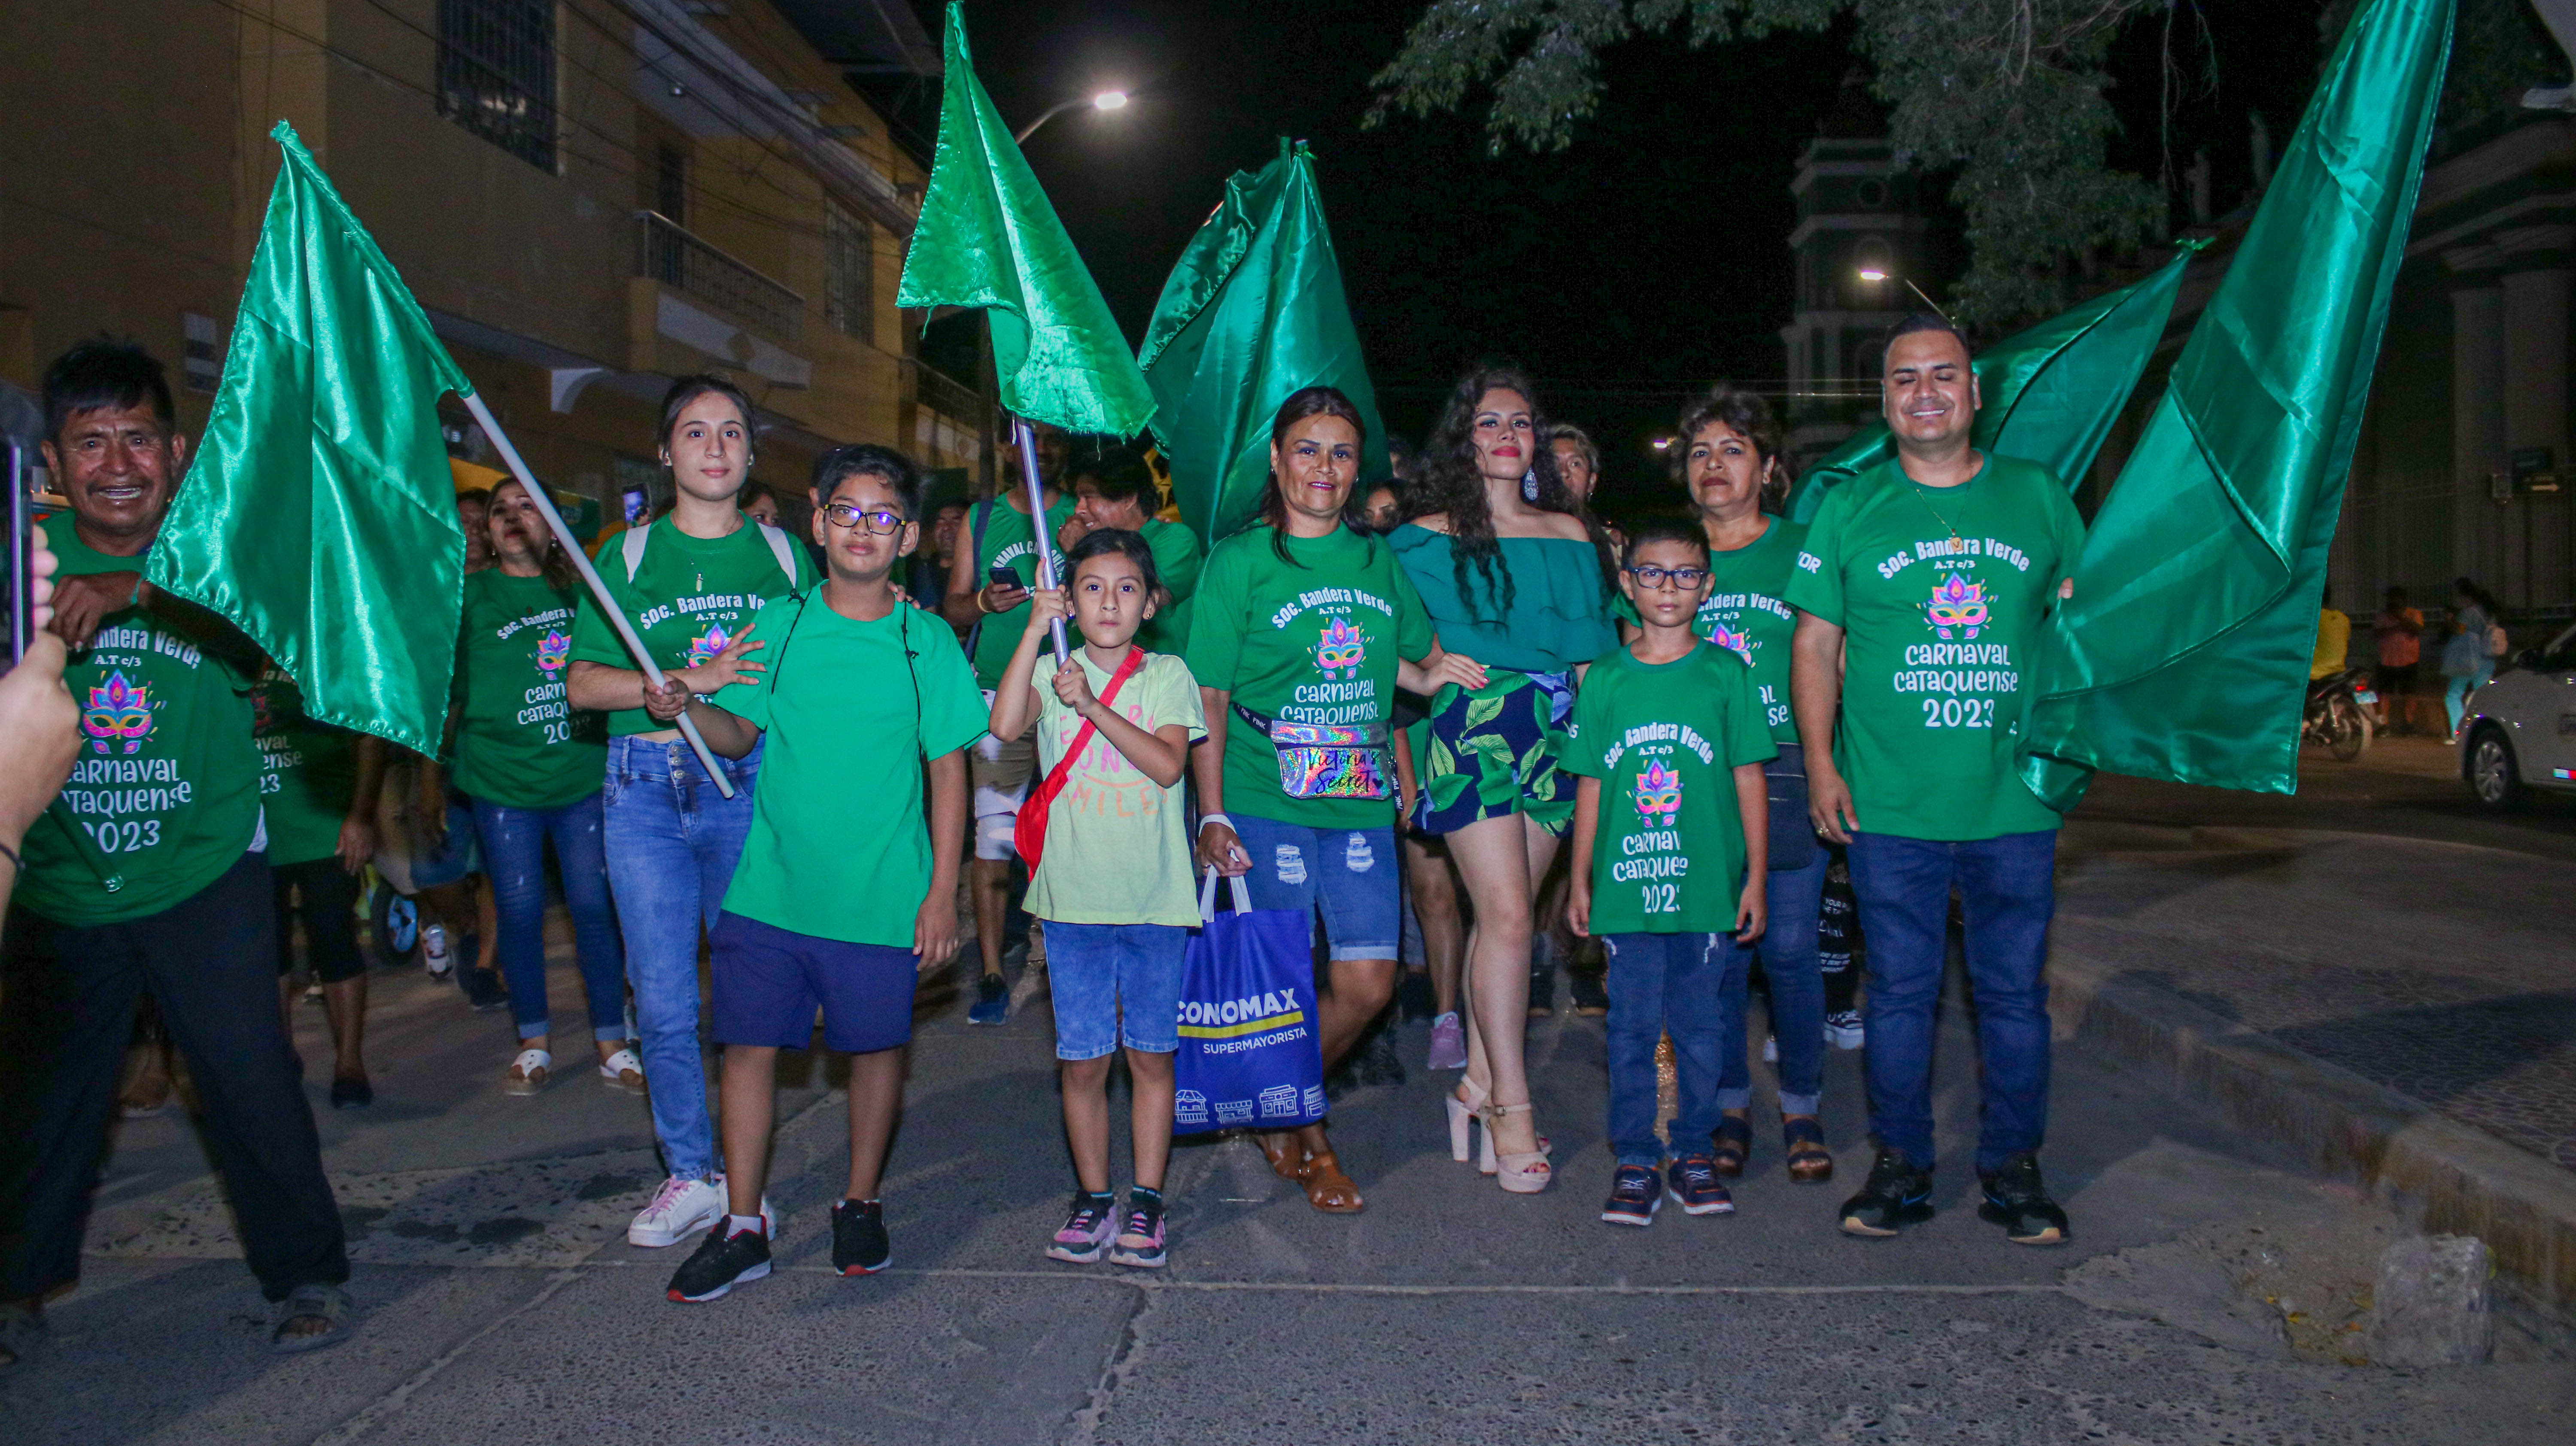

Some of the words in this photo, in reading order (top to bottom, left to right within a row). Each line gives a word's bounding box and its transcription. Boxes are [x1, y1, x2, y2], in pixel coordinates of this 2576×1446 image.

[993, 542, 1025, 568] RNAVAL
[1915, 537, 1981, 560] Bandra
[1985, 538, 2030, 571] Verde
[676, 594, 743, 614] Bandera
[1299, 587, 1353, 608] Bandera
[1354, 589, 1392, 617] Verde
[1336, 606, 1352, 614] c/3
[1698, 594, 1746, 612] ndera
[520, 608, 567, 626] Bandera
[696, 612, 717, 621] A.T
[719, 611, 738, 621] c/3
[94, 626, 149, 650] ndera
[94, 655, 119, 665] A.T
[121, 656, 142, 668] c/3
[1253, 717, 1266, 729] PINK
[1923, 699, 1995, 728] 2023
[1625, 722, 1679, 747] Bandera
[1680, 725, 1714, 764] Verde
[1078, 742, 1138, 773] ON
[1203, 1027, 1307, 1054] SUPERMAYORISTA
